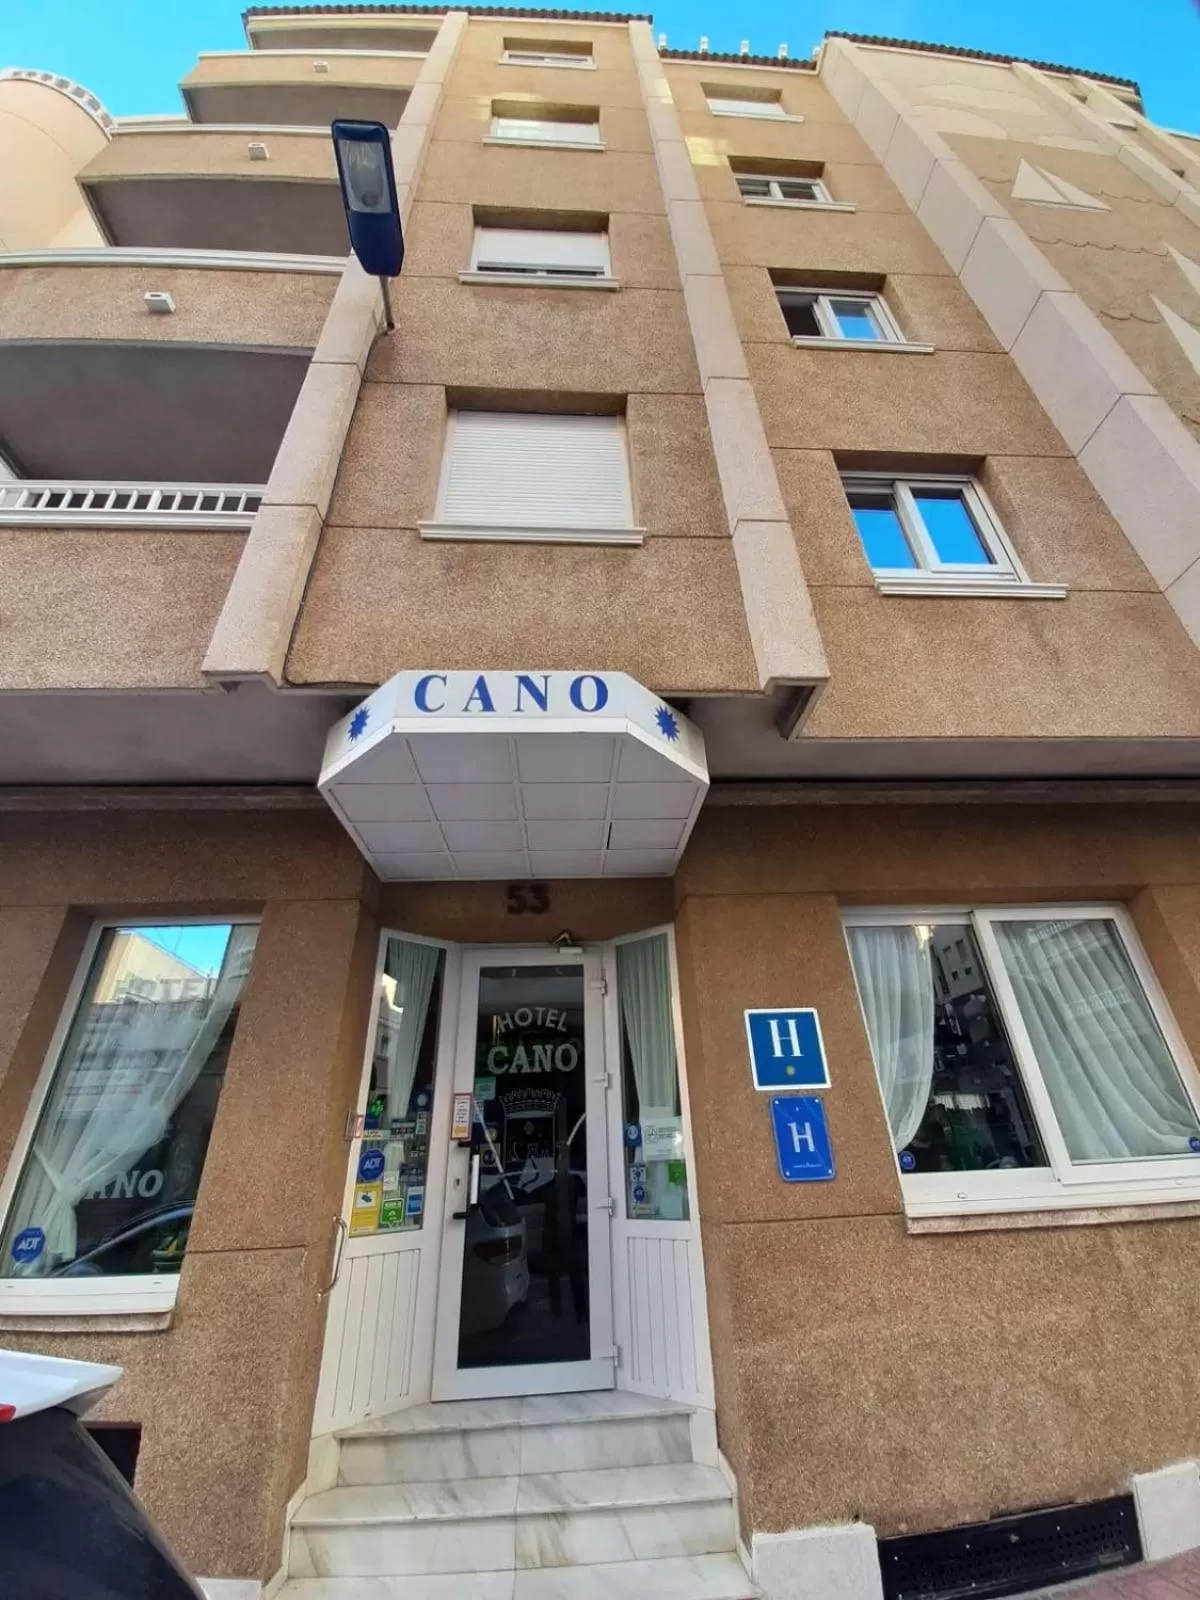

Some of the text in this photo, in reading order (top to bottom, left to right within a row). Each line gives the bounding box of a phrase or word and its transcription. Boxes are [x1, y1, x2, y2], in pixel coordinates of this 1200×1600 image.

[413, 674, 609, 713] CANO
[496, 1007, 568, 1034] HOTEL
[767, 1018, 804, 1058] H
[487, 1042, 578, 1075] CANO
[788, 1121, 816, 1153] H
[16, 1237, 42, 1250] ADT
